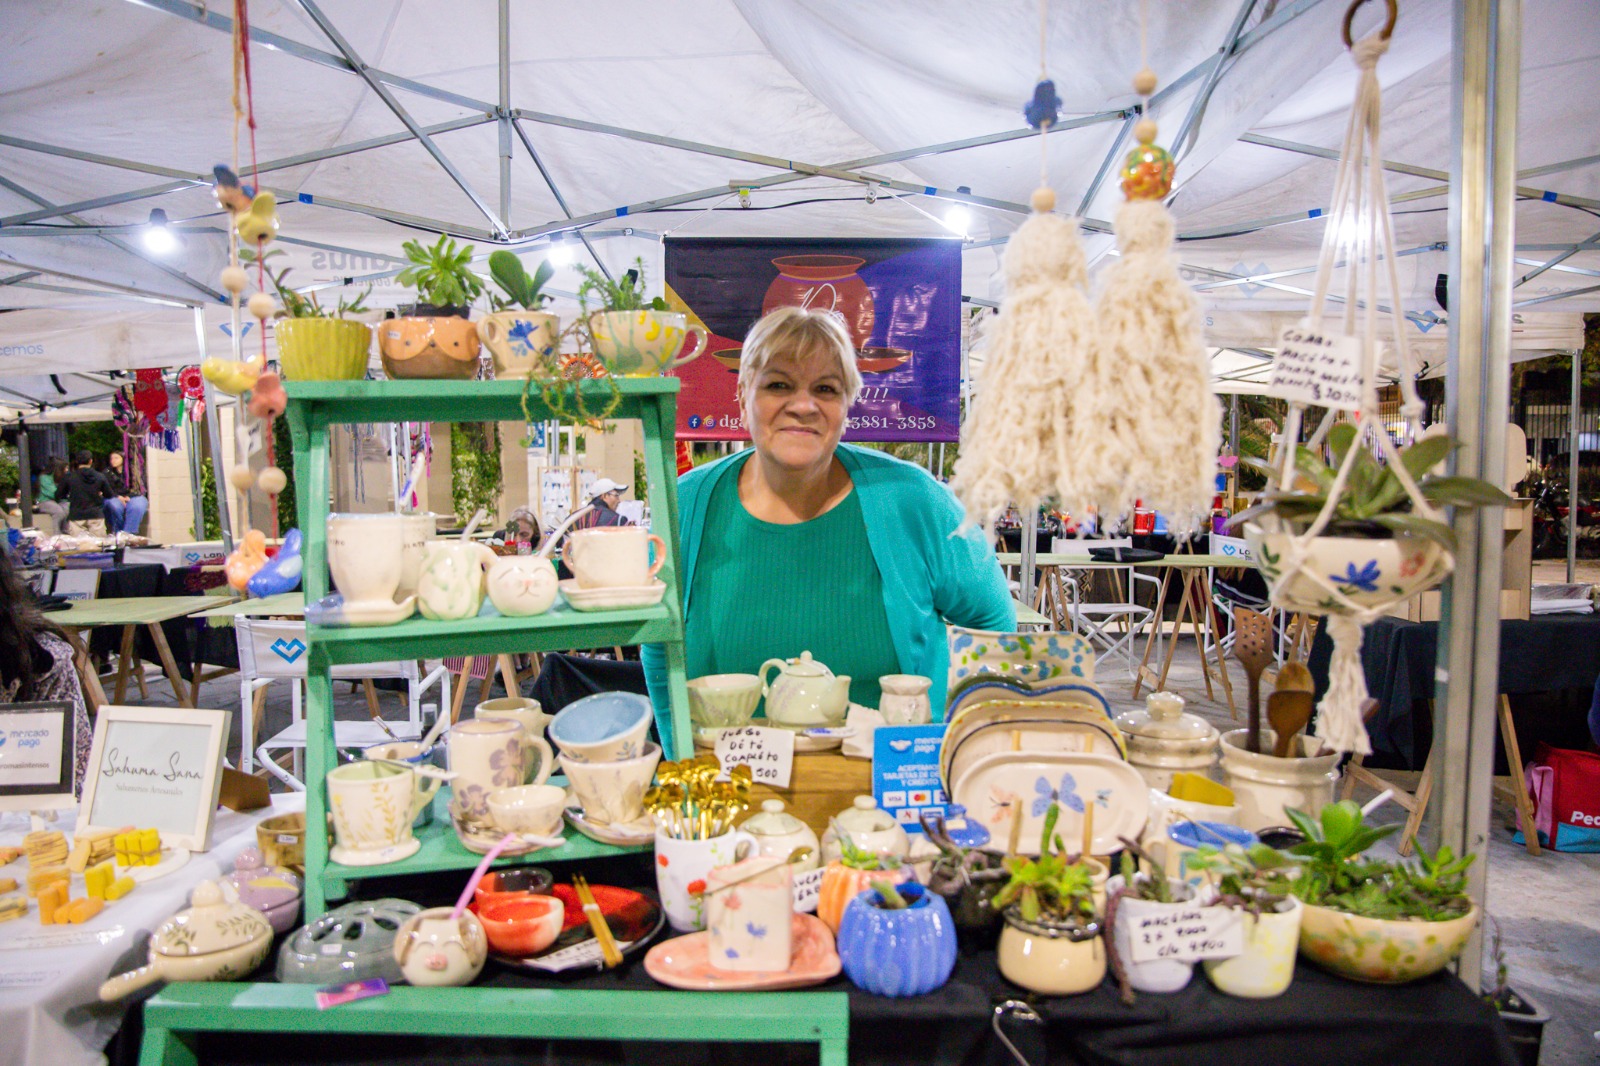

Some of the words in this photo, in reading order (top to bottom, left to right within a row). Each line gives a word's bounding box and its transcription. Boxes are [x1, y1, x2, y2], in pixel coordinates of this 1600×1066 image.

[18, 739, 40, 748] pago
[102, 747, 159, 777] Sahuma
[164, 751, 204, 782] Sana
